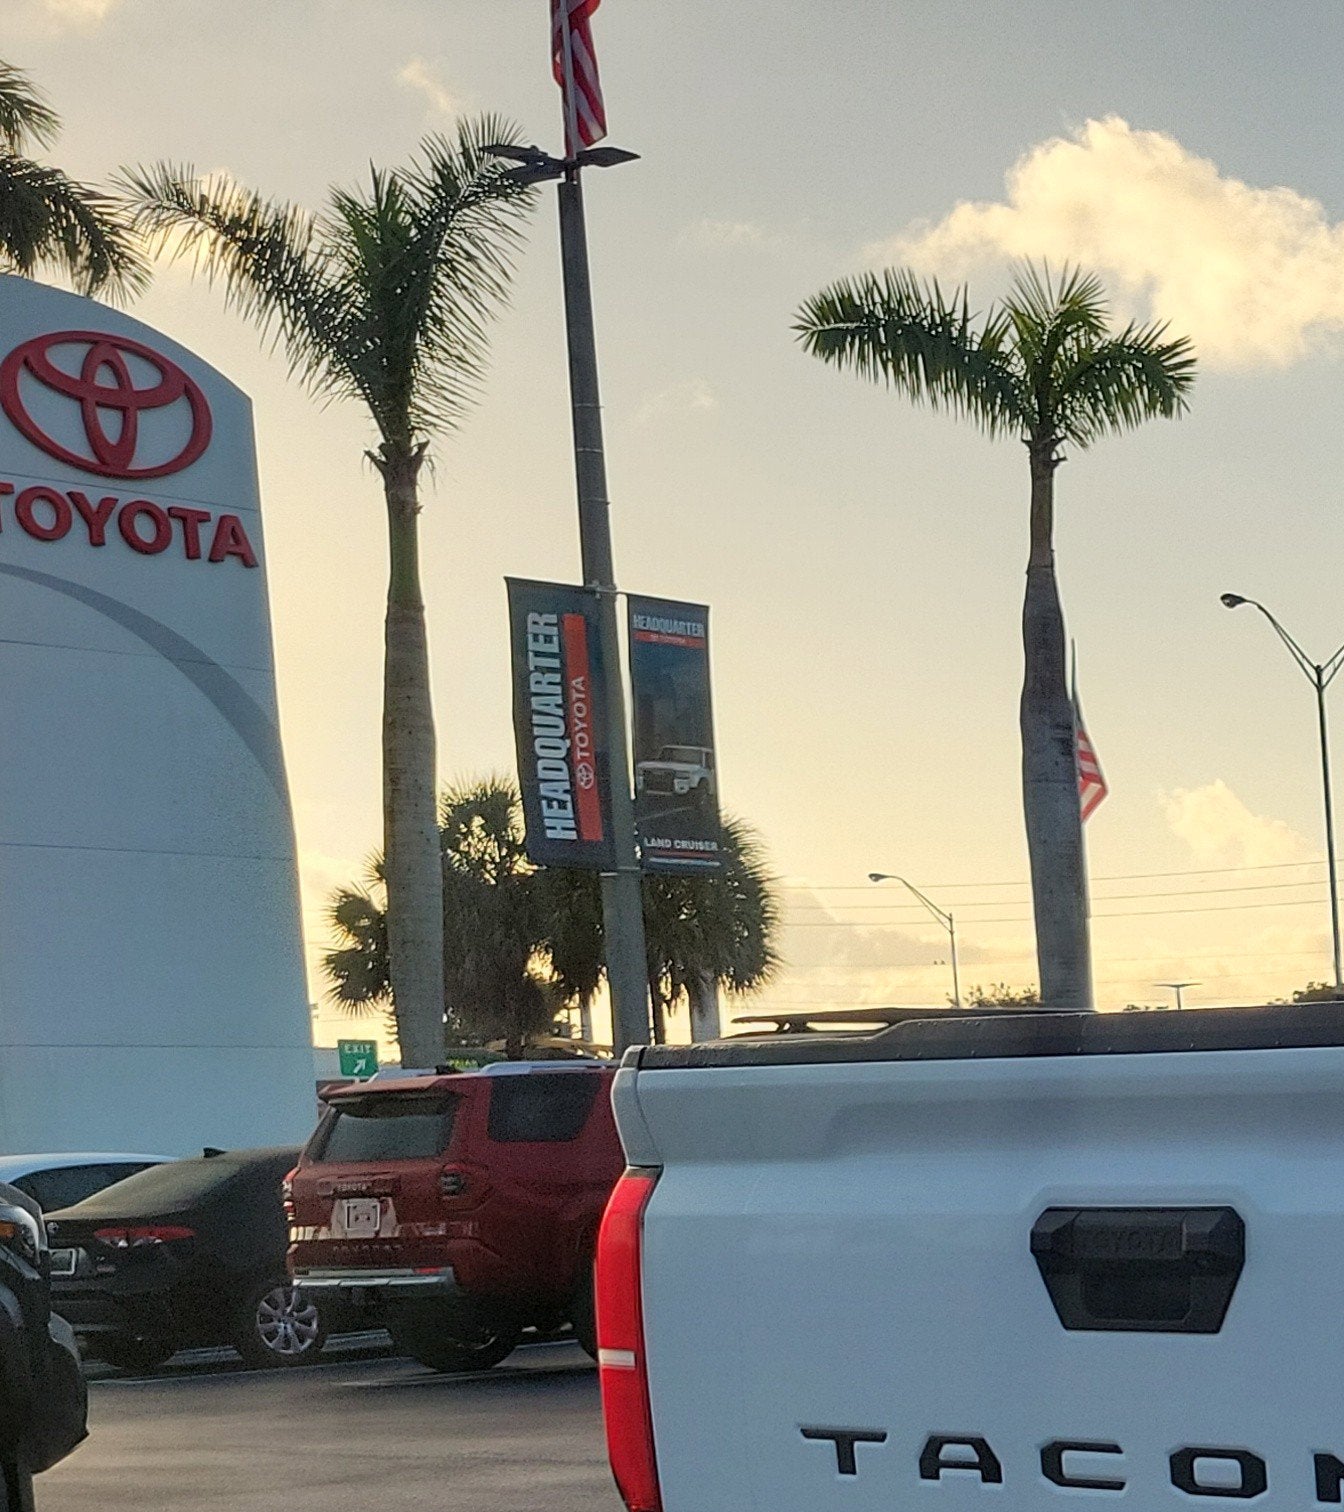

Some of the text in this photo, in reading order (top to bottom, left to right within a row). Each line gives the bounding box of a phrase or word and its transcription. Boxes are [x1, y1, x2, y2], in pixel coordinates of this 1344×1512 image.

[527, 612, 578, 841] HEADQUARTER
[571, 676, 593, 760] TOYOTA
[643, 836, 719, 852] LAND CRUISER
[344, 1043, 372, 1054] EXIT
